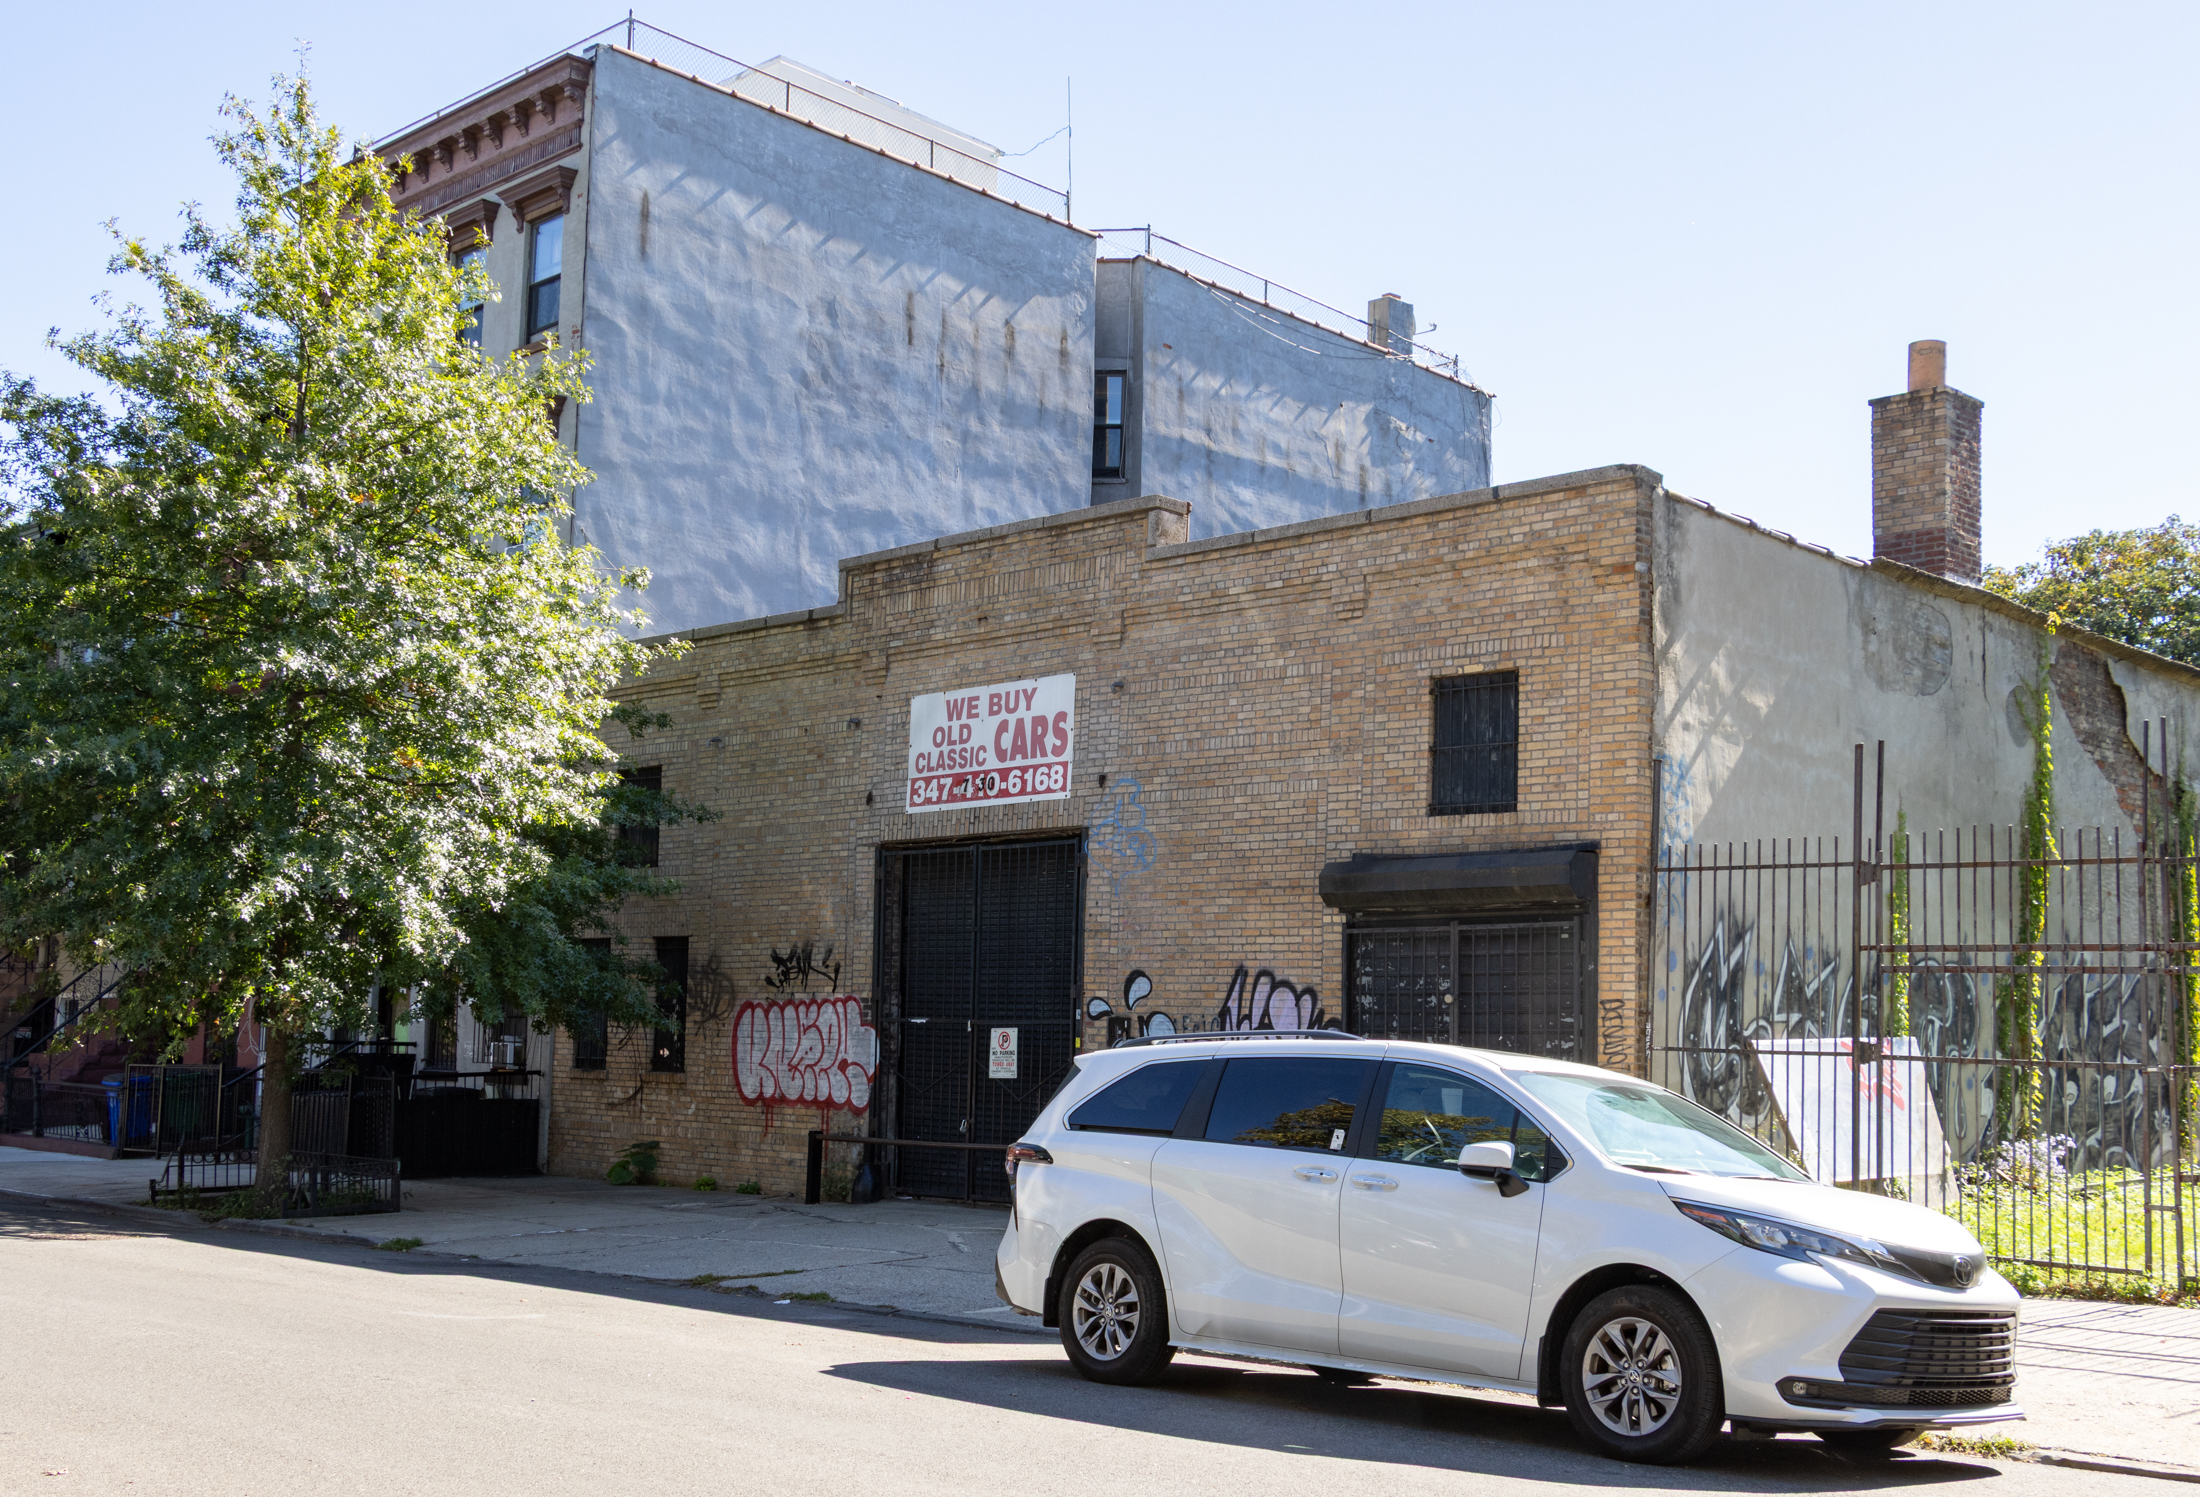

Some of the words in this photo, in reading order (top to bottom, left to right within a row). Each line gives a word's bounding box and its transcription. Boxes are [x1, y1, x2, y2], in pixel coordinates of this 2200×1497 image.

[946, 696, 980, 722] WE
[988, 687, 1038, 717] BUY
[932, 723, 972, 748] OLD
[994, 711, 1069, 763] CARS
[915, 745, 987, 774] CLASSIC
